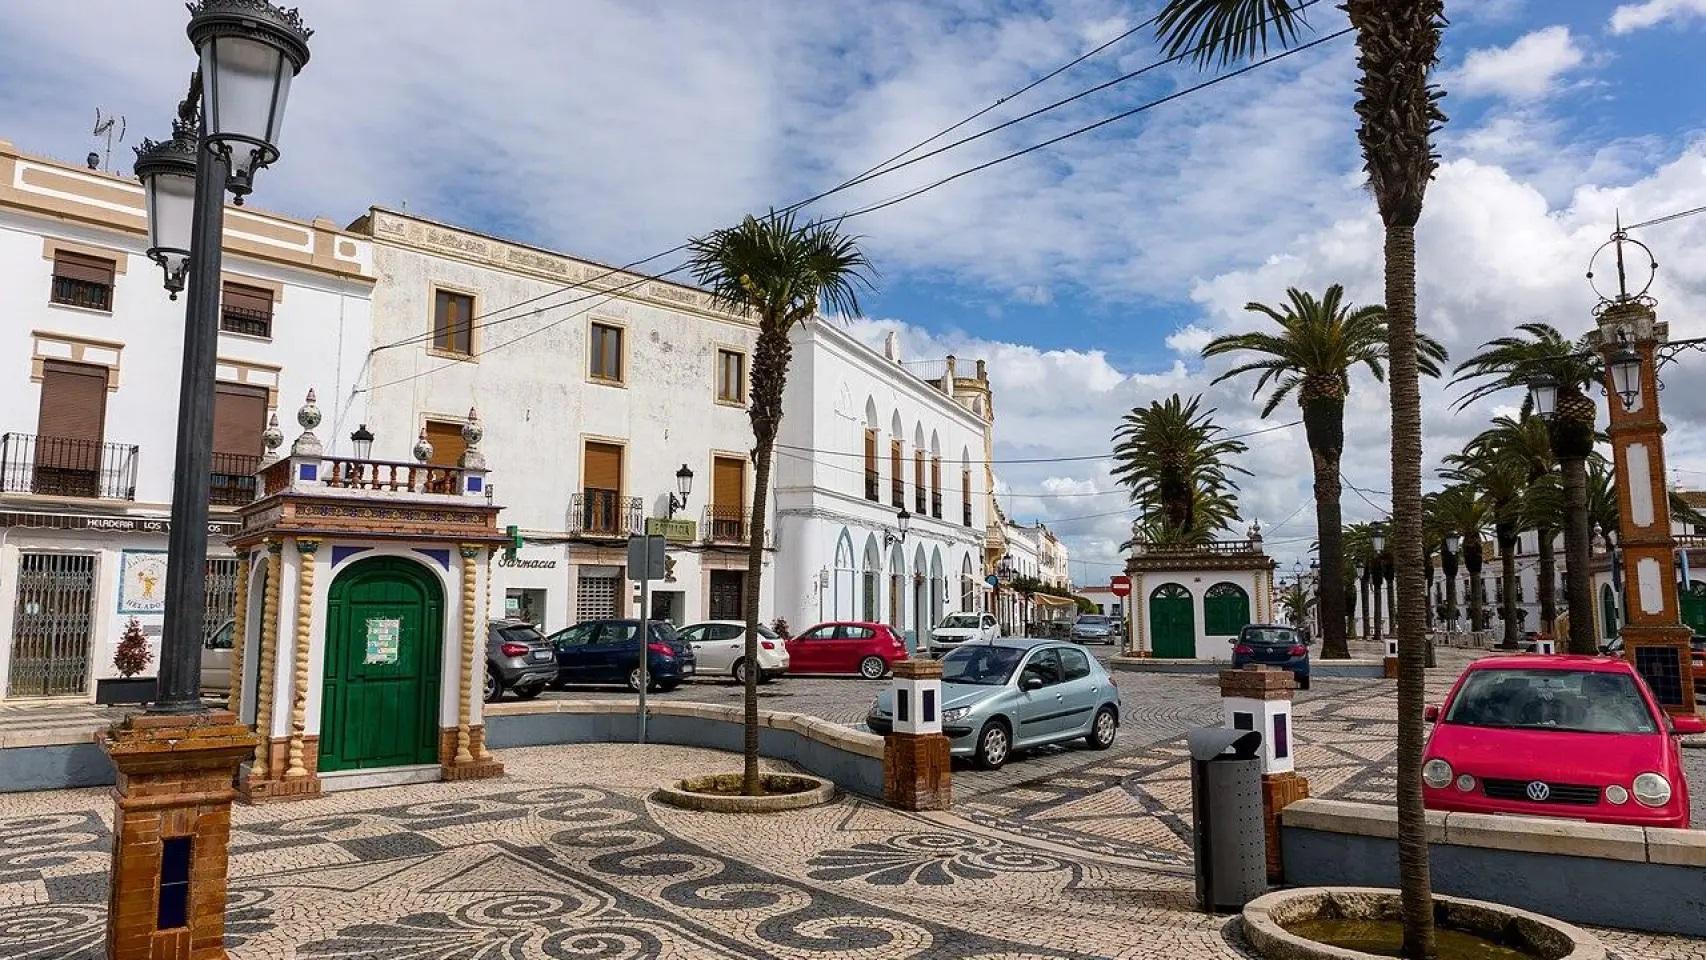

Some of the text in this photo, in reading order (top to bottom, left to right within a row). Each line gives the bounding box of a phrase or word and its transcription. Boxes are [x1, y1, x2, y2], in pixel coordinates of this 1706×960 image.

[87, 519, 134, 529] HELADERIA
[143, 521, 161, 530] LOS
[498, 552, 557, 569] Farmacia
[1527, 781, 1550, 800] VW
